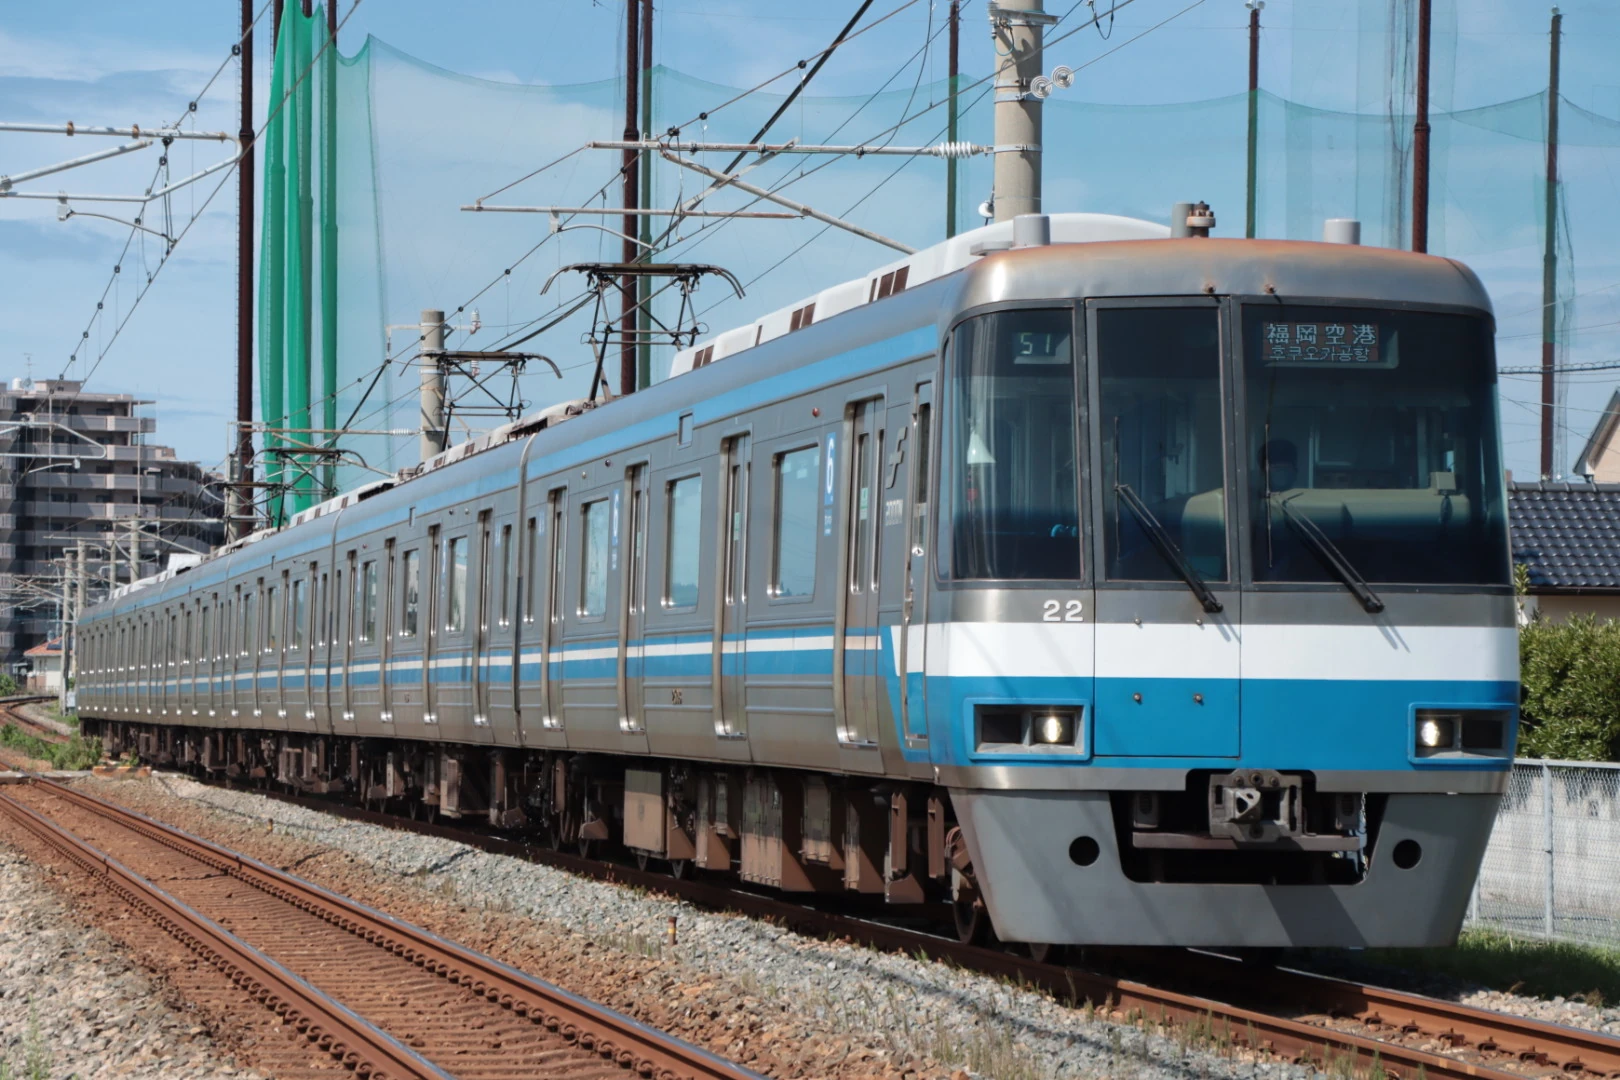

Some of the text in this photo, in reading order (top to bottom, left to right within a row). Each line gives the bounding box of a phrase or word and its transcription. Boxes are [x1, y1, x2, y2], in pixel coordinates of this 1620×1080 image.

[1266, 323, 1377, 345] 福岡空港
[826, 438, 835, 494] 6
[1042, 599, 1084, 622] 22
